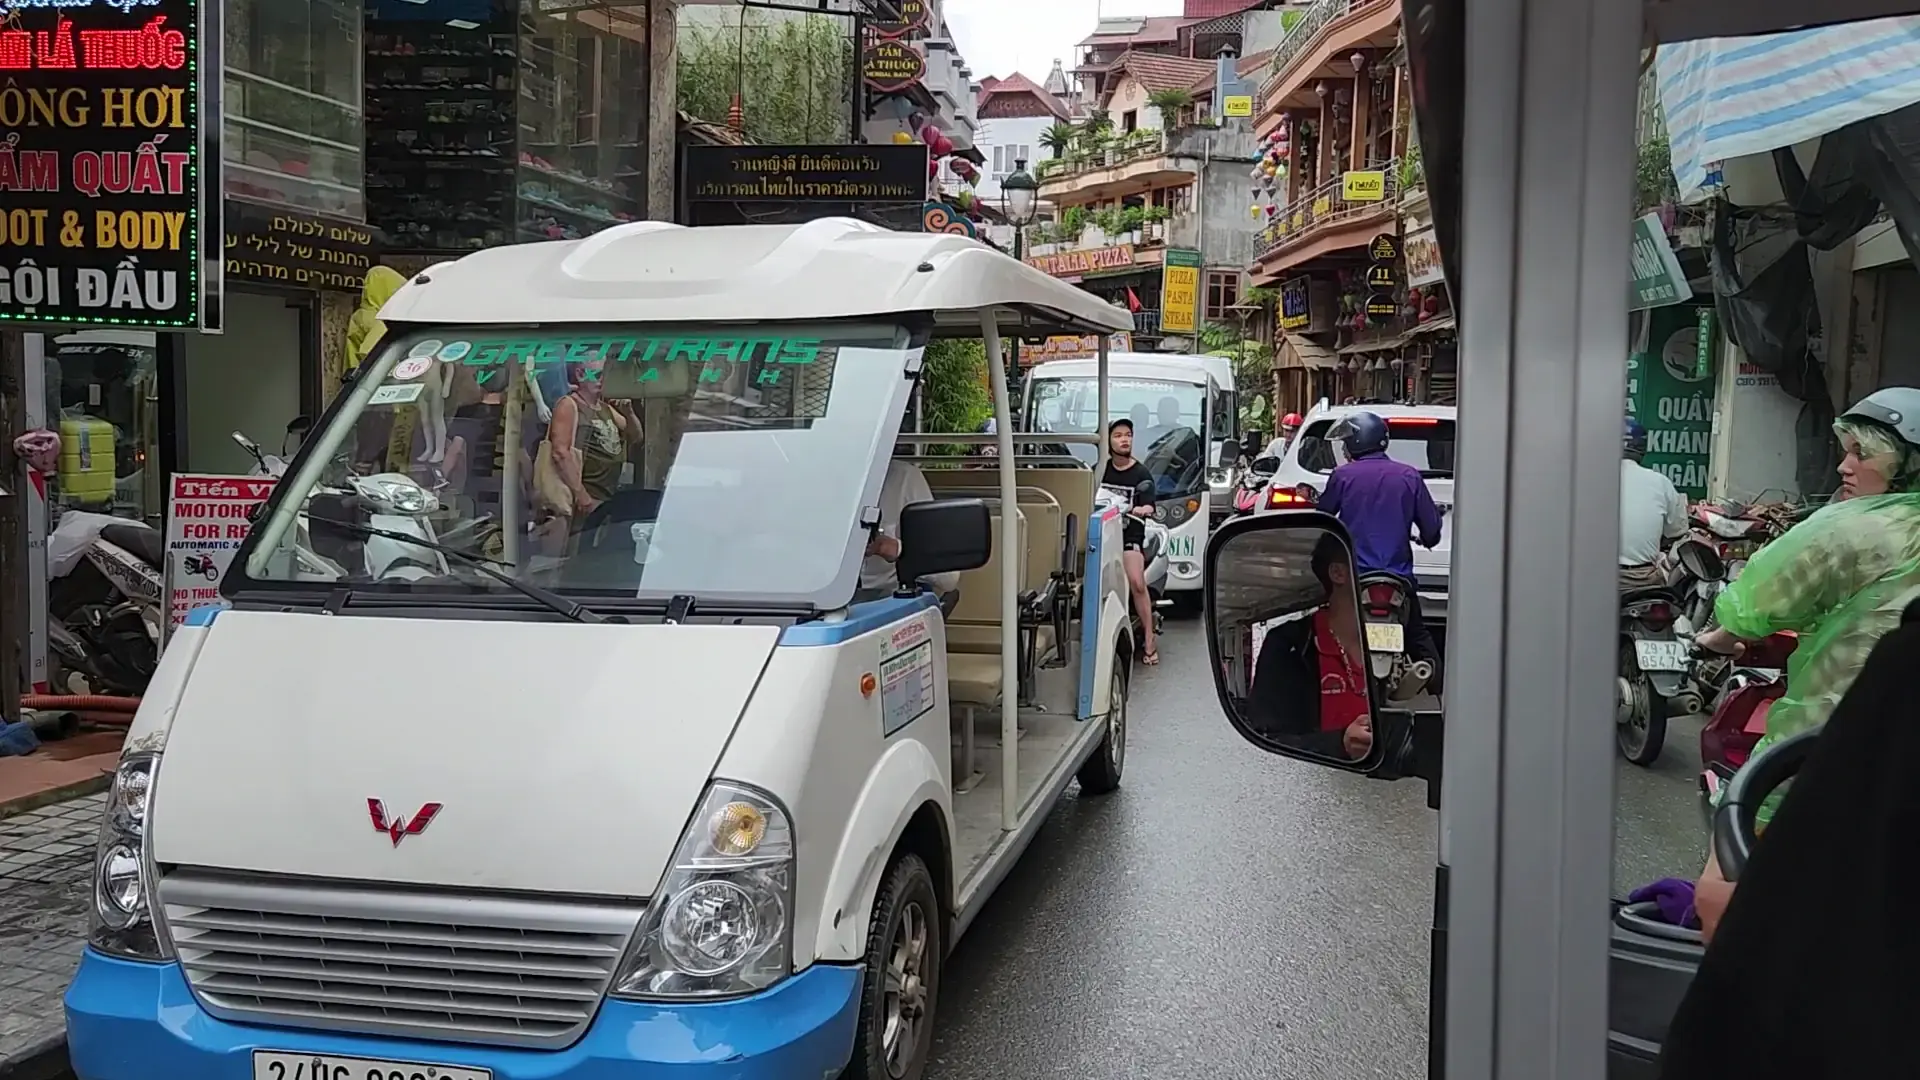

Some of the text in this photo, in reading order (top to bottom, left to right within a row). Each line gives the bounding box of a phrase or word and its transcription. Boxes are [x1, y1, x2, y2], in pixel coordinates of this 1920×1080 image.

[37, 21, 76, 68] LÁ
[80, 16, 185, 69] THUỐC
[101, 84, 185, 128] HƠI
[73, 134, 190, 197] QUẤT
[60, 210, 85, 247] &
[96, 210, 186, 250] BODY
[330, 226, 372, 245] שלום
[320, 248, 370, 268] החנות
[1091, 246, 1133, 269] PIZZA
[76, 255, 177, 310] ĐẦU
[1170, 270, 1193, 284] PIZZA
[1376, 269, 1389, 279] 11
[1167, 290, 1193, 304] PASTA
[1165, 311, 1192, 325] STEAK
[406, 361, 421, 373] 36
[181, 481, 239, 496] Tiến
[184, 524, 220, 538] FOR
[170, 541, 229, 549] AUTOMATIC
[1183, 536, 1195, 557] 81
